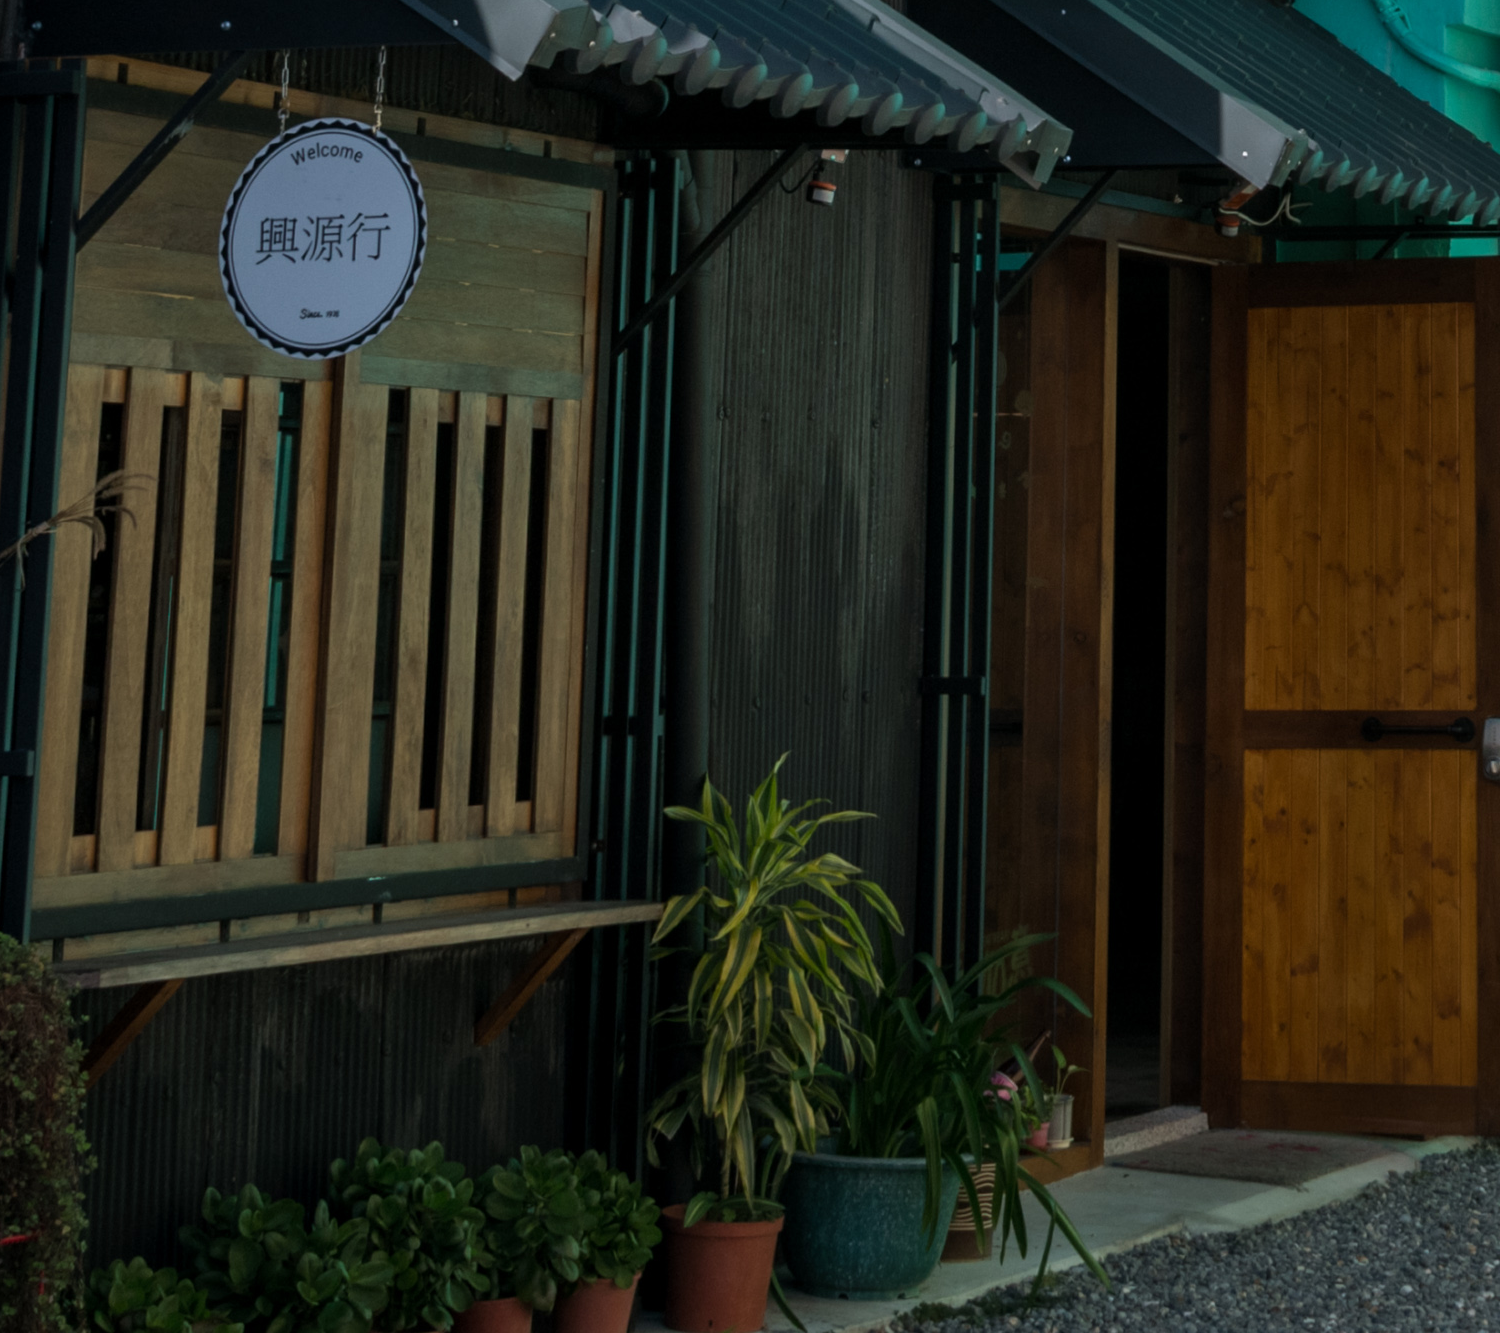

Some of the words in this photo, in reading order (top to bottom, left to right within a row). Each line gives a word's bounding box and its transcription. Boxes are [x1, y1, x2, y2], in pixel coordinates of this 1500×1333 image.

[290, 142, 363, 165] Welcome
[255, 212, 391, 265] 興源行
